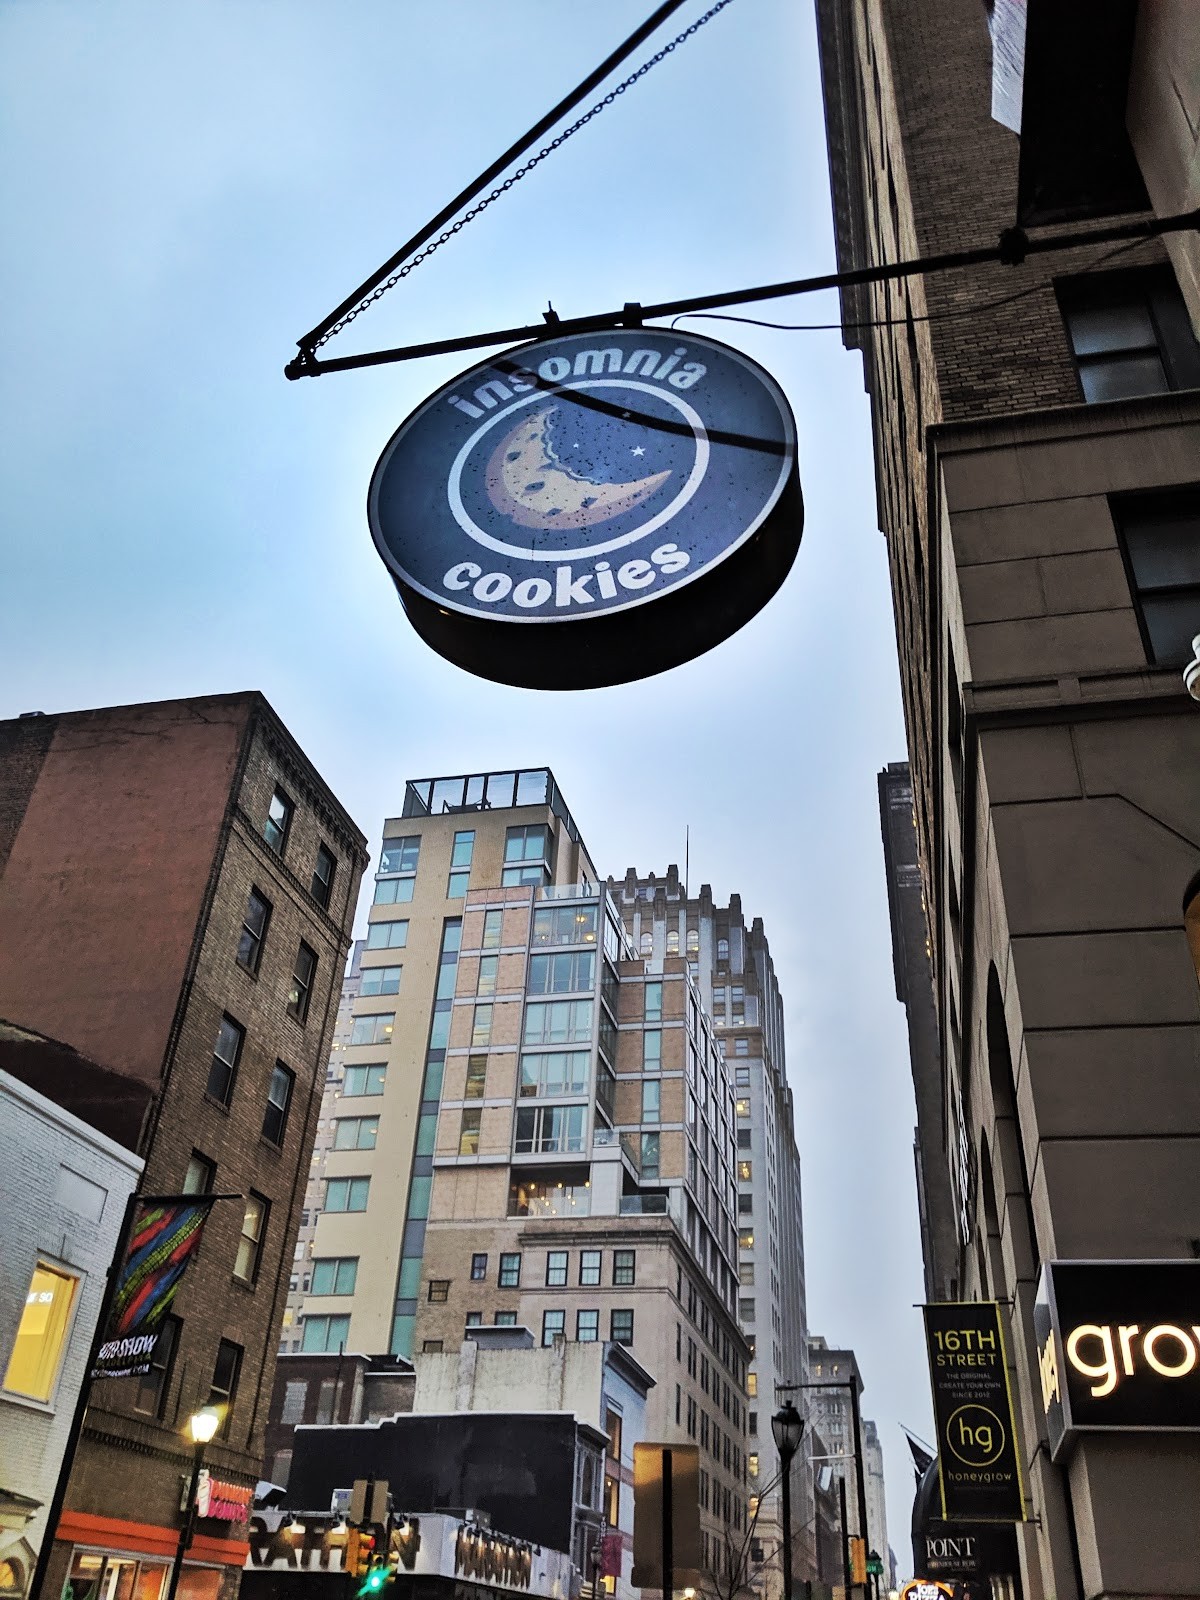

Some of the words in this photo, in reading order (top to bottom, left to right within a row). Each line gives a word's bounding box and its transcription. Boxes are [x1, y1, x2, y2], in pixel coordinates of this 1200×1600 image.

[448, 347, 707, 419] insomnia
[443, 542, 692, 608] cookies
[934, 1330, 995, 1350] 16TH
[937, 1353, 996, 1366] STREET
[1067, 1324, 1200, 1397] gro
[959, 1417, 993, 1453] hg
[948, 1470, 1012, 1483] honeygrow
[926, 1537, 976, 1558] POINT
